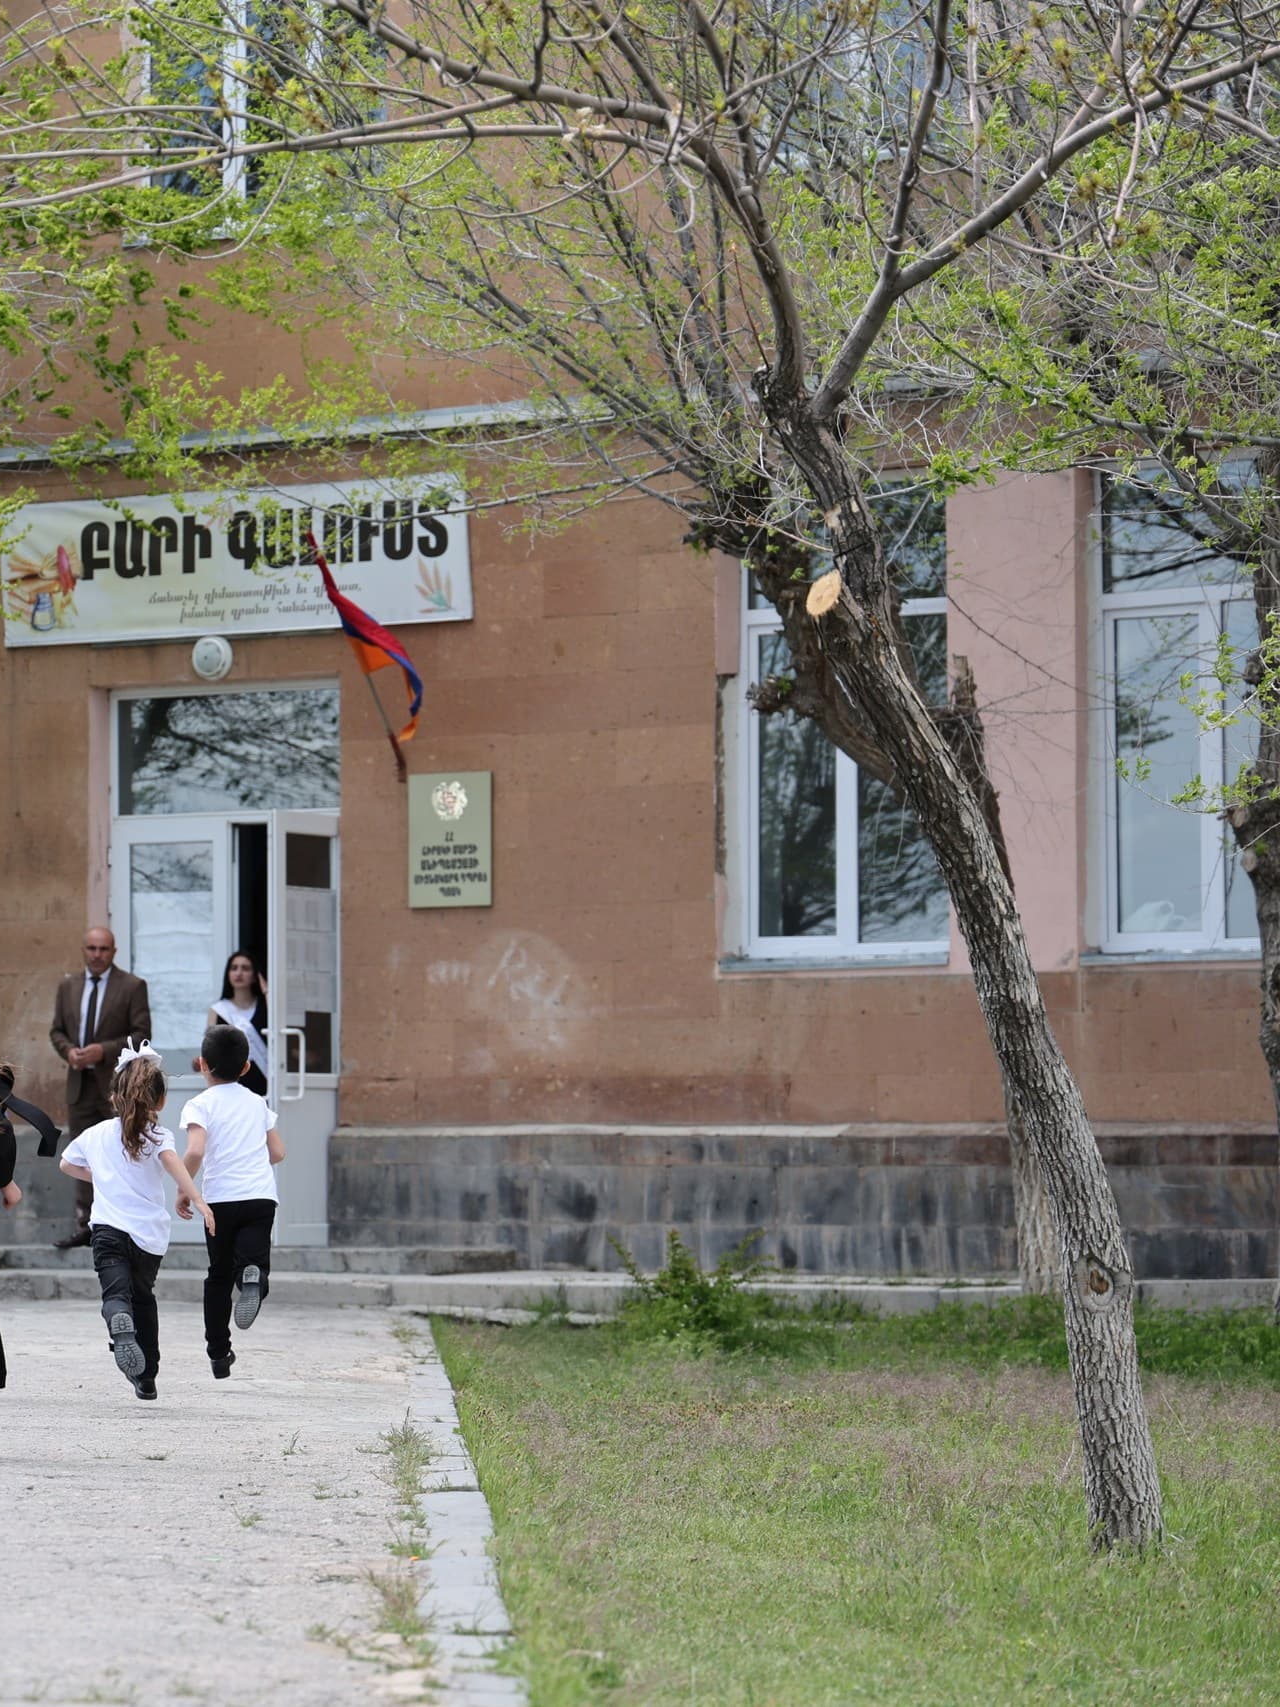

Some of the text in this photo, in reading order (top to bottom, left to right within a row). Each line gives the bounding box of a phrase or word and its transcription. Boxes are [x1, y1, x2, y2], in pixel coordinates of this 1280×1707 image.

[81, 499, 449, 580] ԲԱՐԻ ԳԱԼՈՒՍՏ
[313, 582, 363, 599] զատ,
